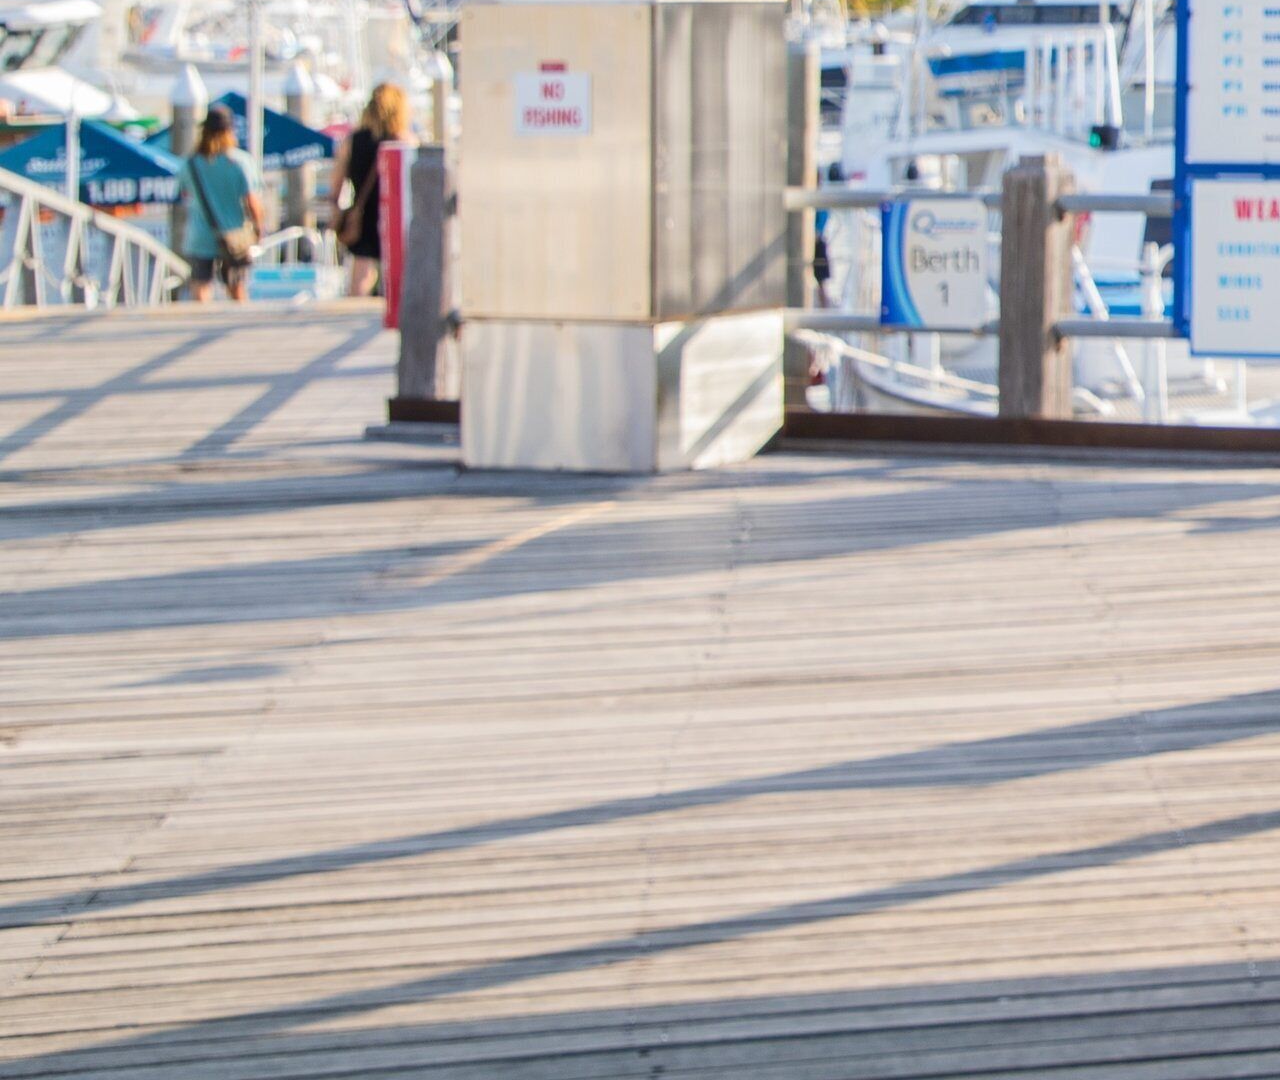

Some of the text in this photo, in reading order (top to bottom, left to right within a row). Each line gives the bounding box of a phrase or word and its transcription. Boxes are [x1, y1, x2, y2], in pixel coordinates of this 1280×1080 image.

[543, 81, 566, 101] NO
[524, 106, 582, 127] FISHING
[911, 245, 981, 274] Berth
[937, 281, 950, 308] 1
